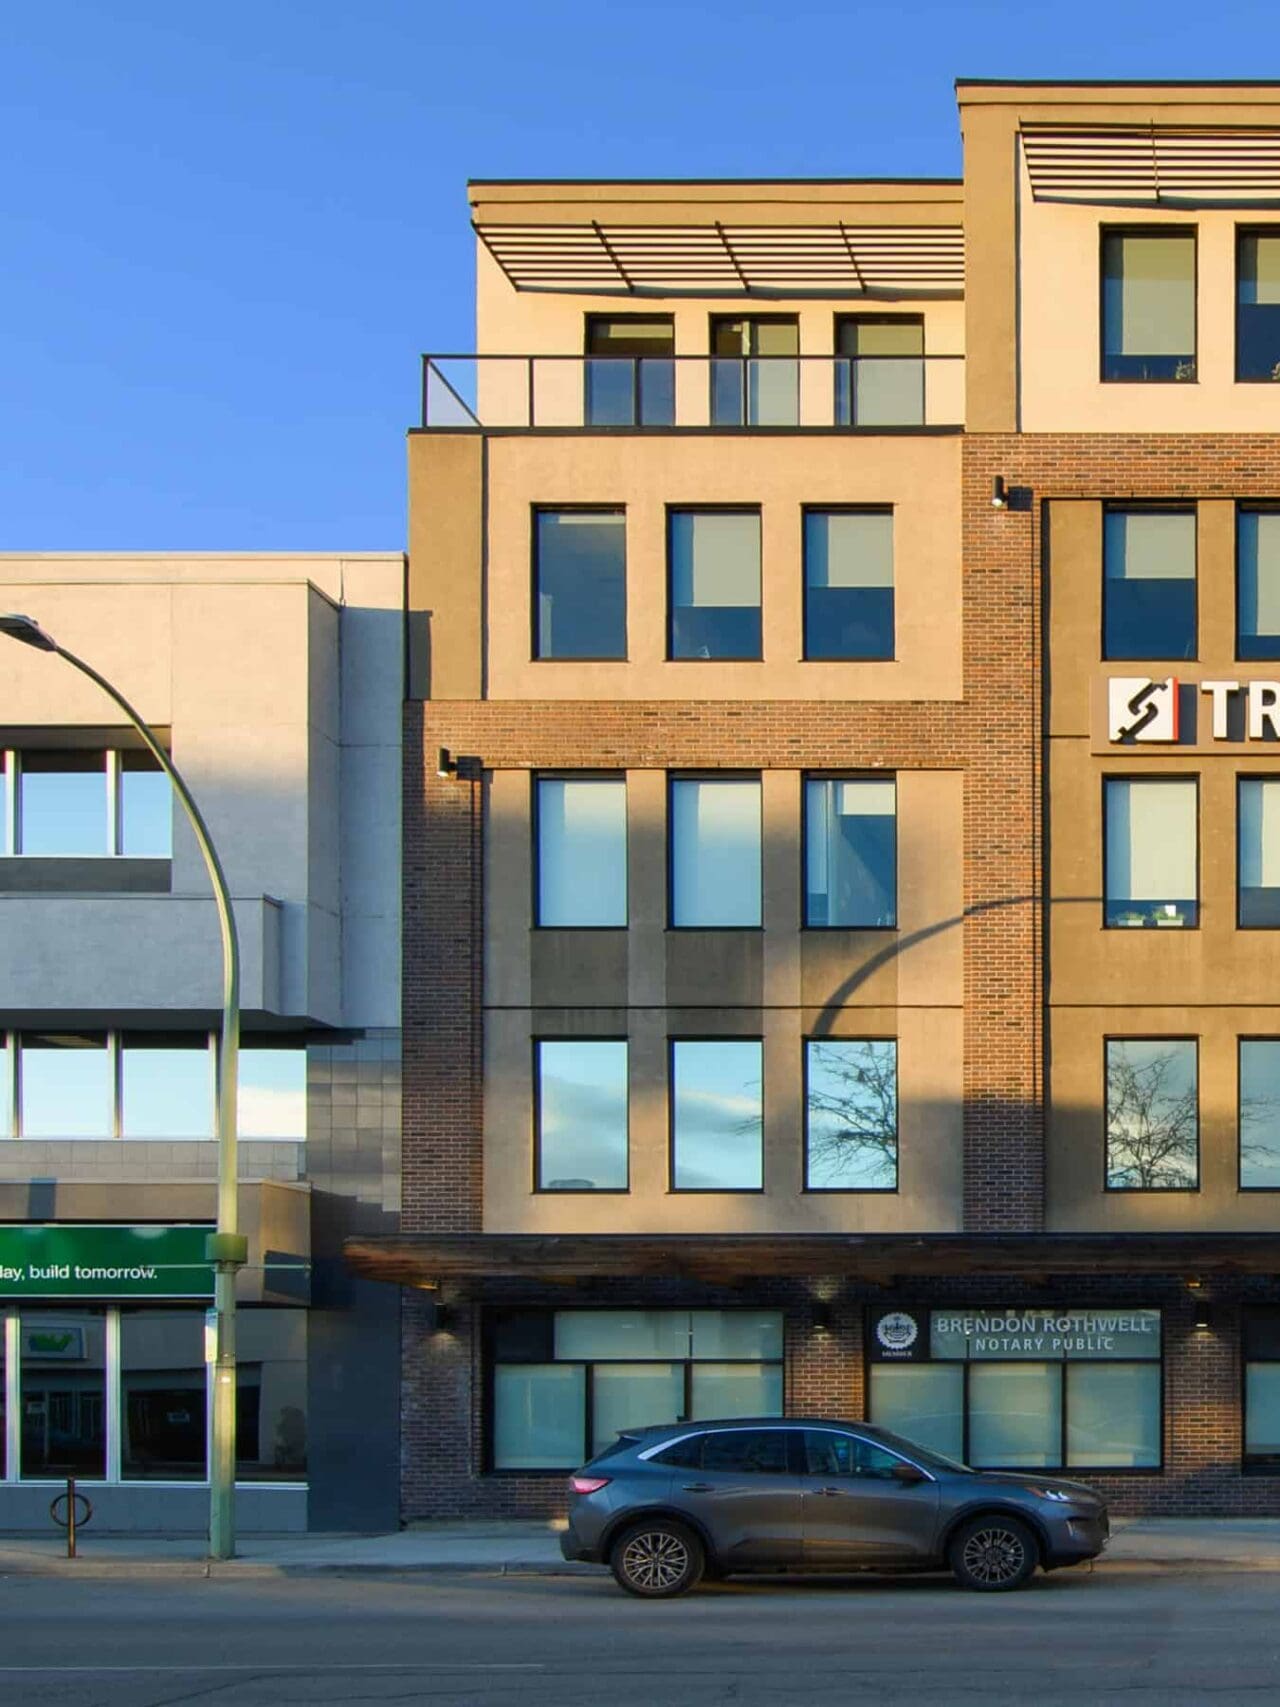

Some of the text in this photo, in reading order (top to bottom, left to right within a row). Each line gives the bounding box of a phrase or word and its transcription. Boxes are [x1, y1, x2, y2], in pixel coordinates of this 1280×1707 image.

[0, 1265, 158, 1281] ay, build tomorrow.
[937, 1318, 1150, 1333] BRENDON ROTHWELL
[975, 1338, 1114, 1351] NOTARY PUBLIC
